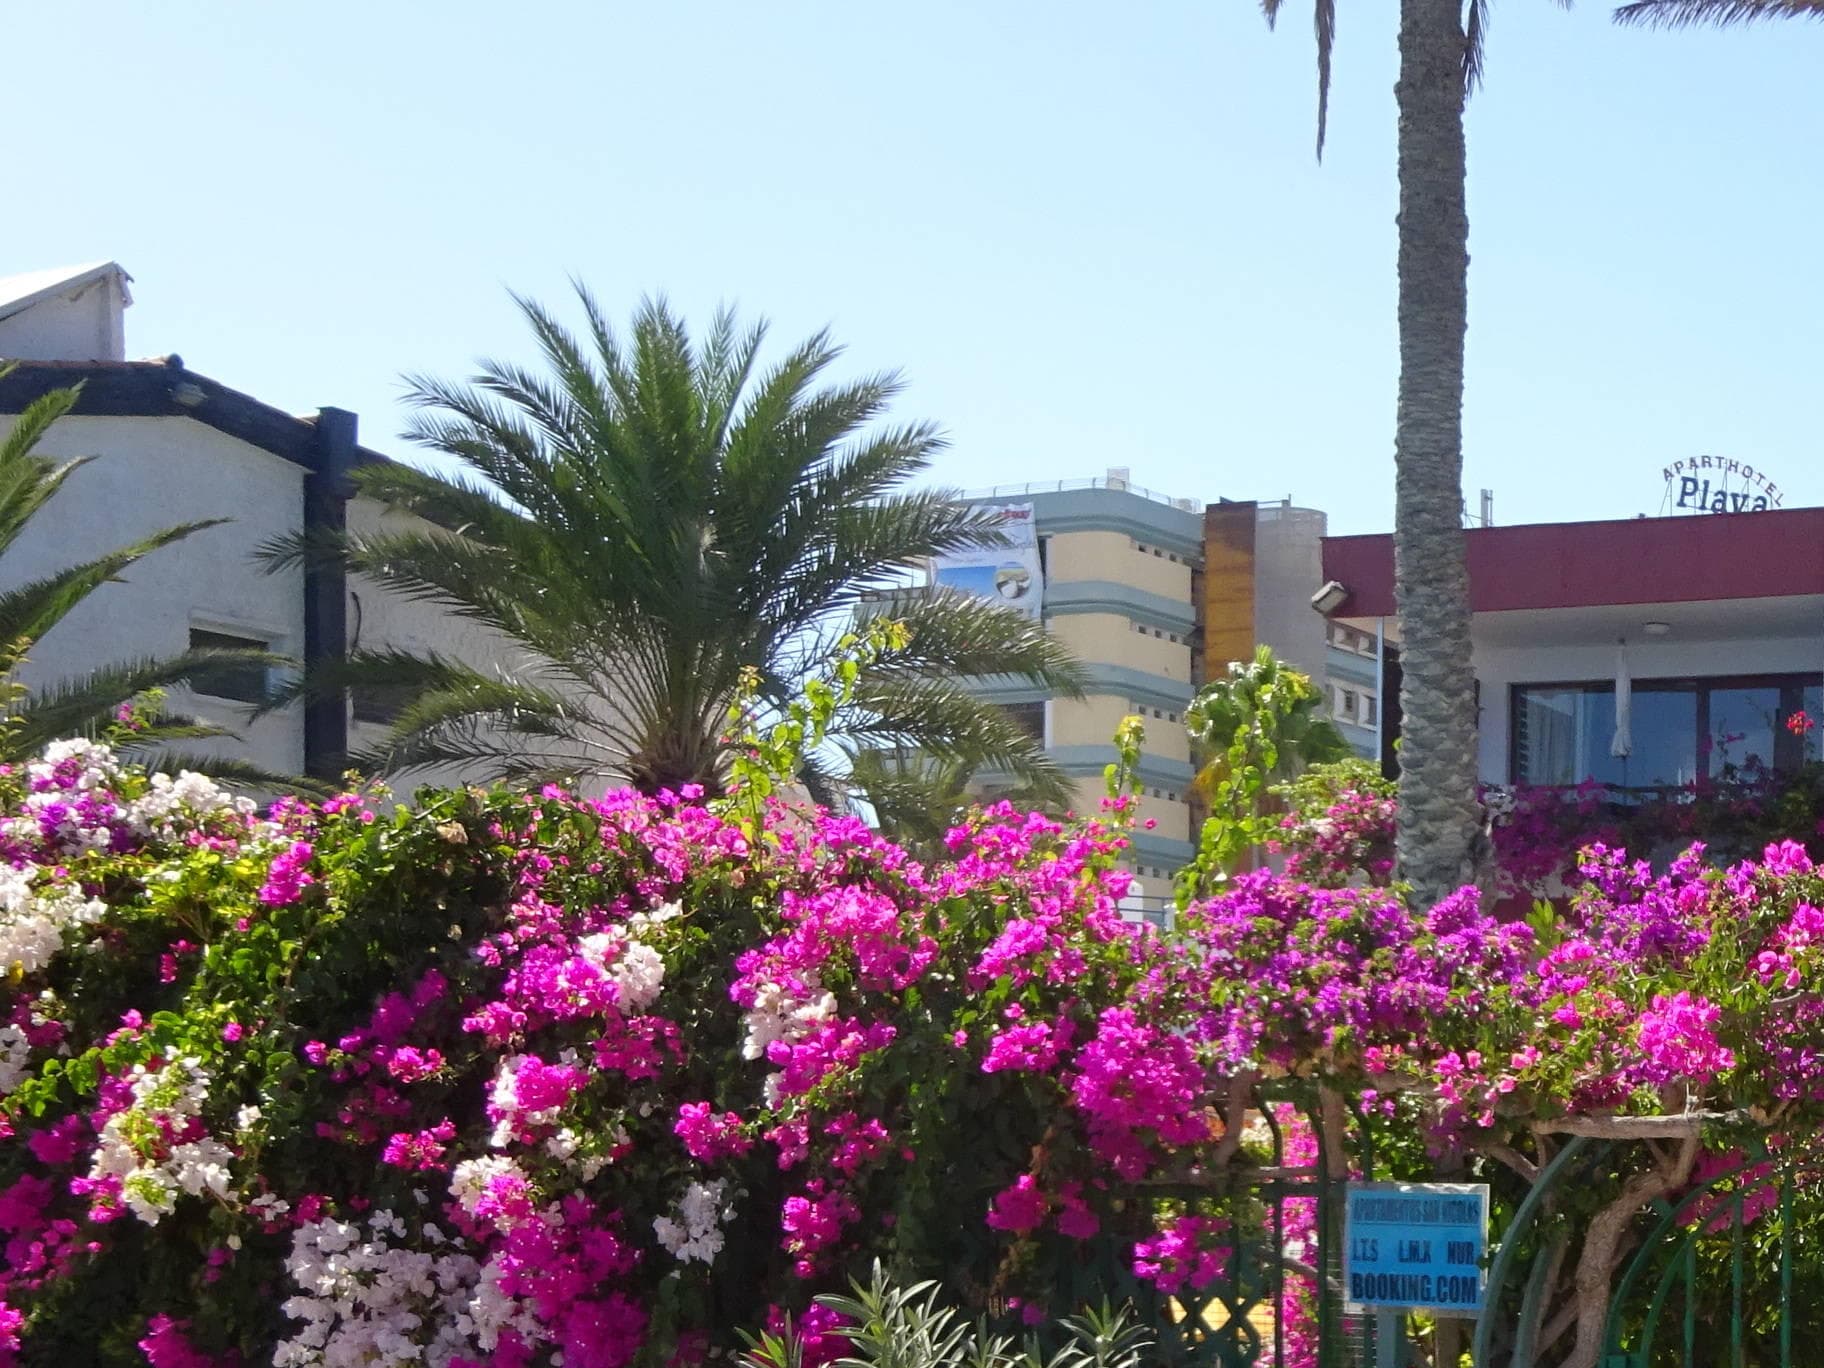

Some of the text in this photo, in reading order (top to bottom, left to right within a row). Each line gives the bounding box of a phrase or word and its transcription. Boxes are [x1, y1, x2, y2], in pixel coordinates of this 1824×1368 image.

[1662, 455, 1784, 507] APARTHOTEL
[1676, 476, 1768, 513] Playa
[1351, 1273, 1477, 1304] BOOKING.COM
